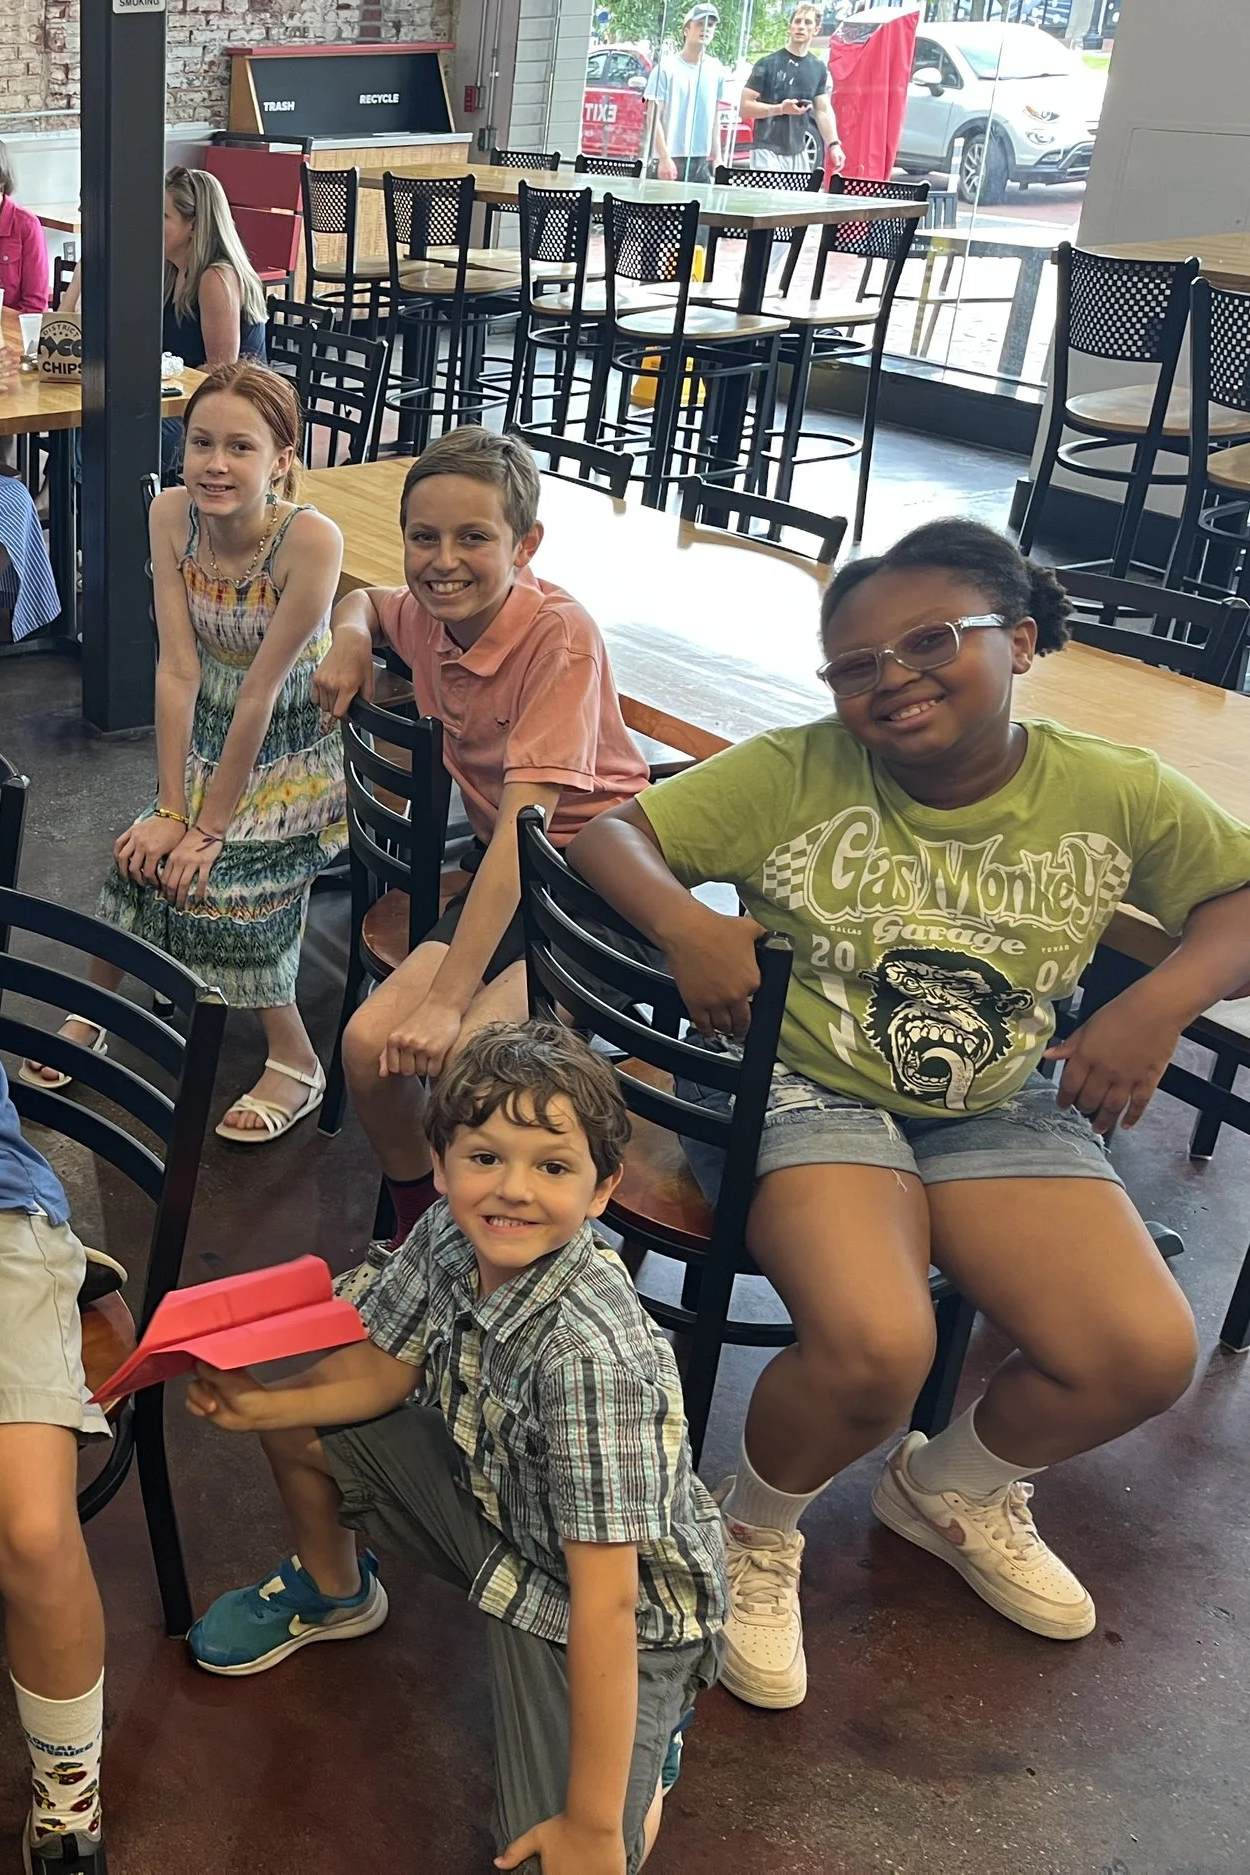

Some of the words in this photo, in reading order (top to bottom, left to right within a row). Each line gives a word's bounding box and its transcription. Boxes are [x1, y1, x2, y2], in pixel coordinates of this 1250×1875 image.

[359, 94, 400, 104] RECYCLE
[263, 101, 295, 112] TRASH
[43, 324, 79, 337] DISTRICT
[829, 925, 862, 936] DALLAS
[872, 915, 1028, 956] Garage
[810, 934, 856, 973] 20
[1041, 944, 1070, 953] TEXAS
[1035, 953, 1081, 993] 04
